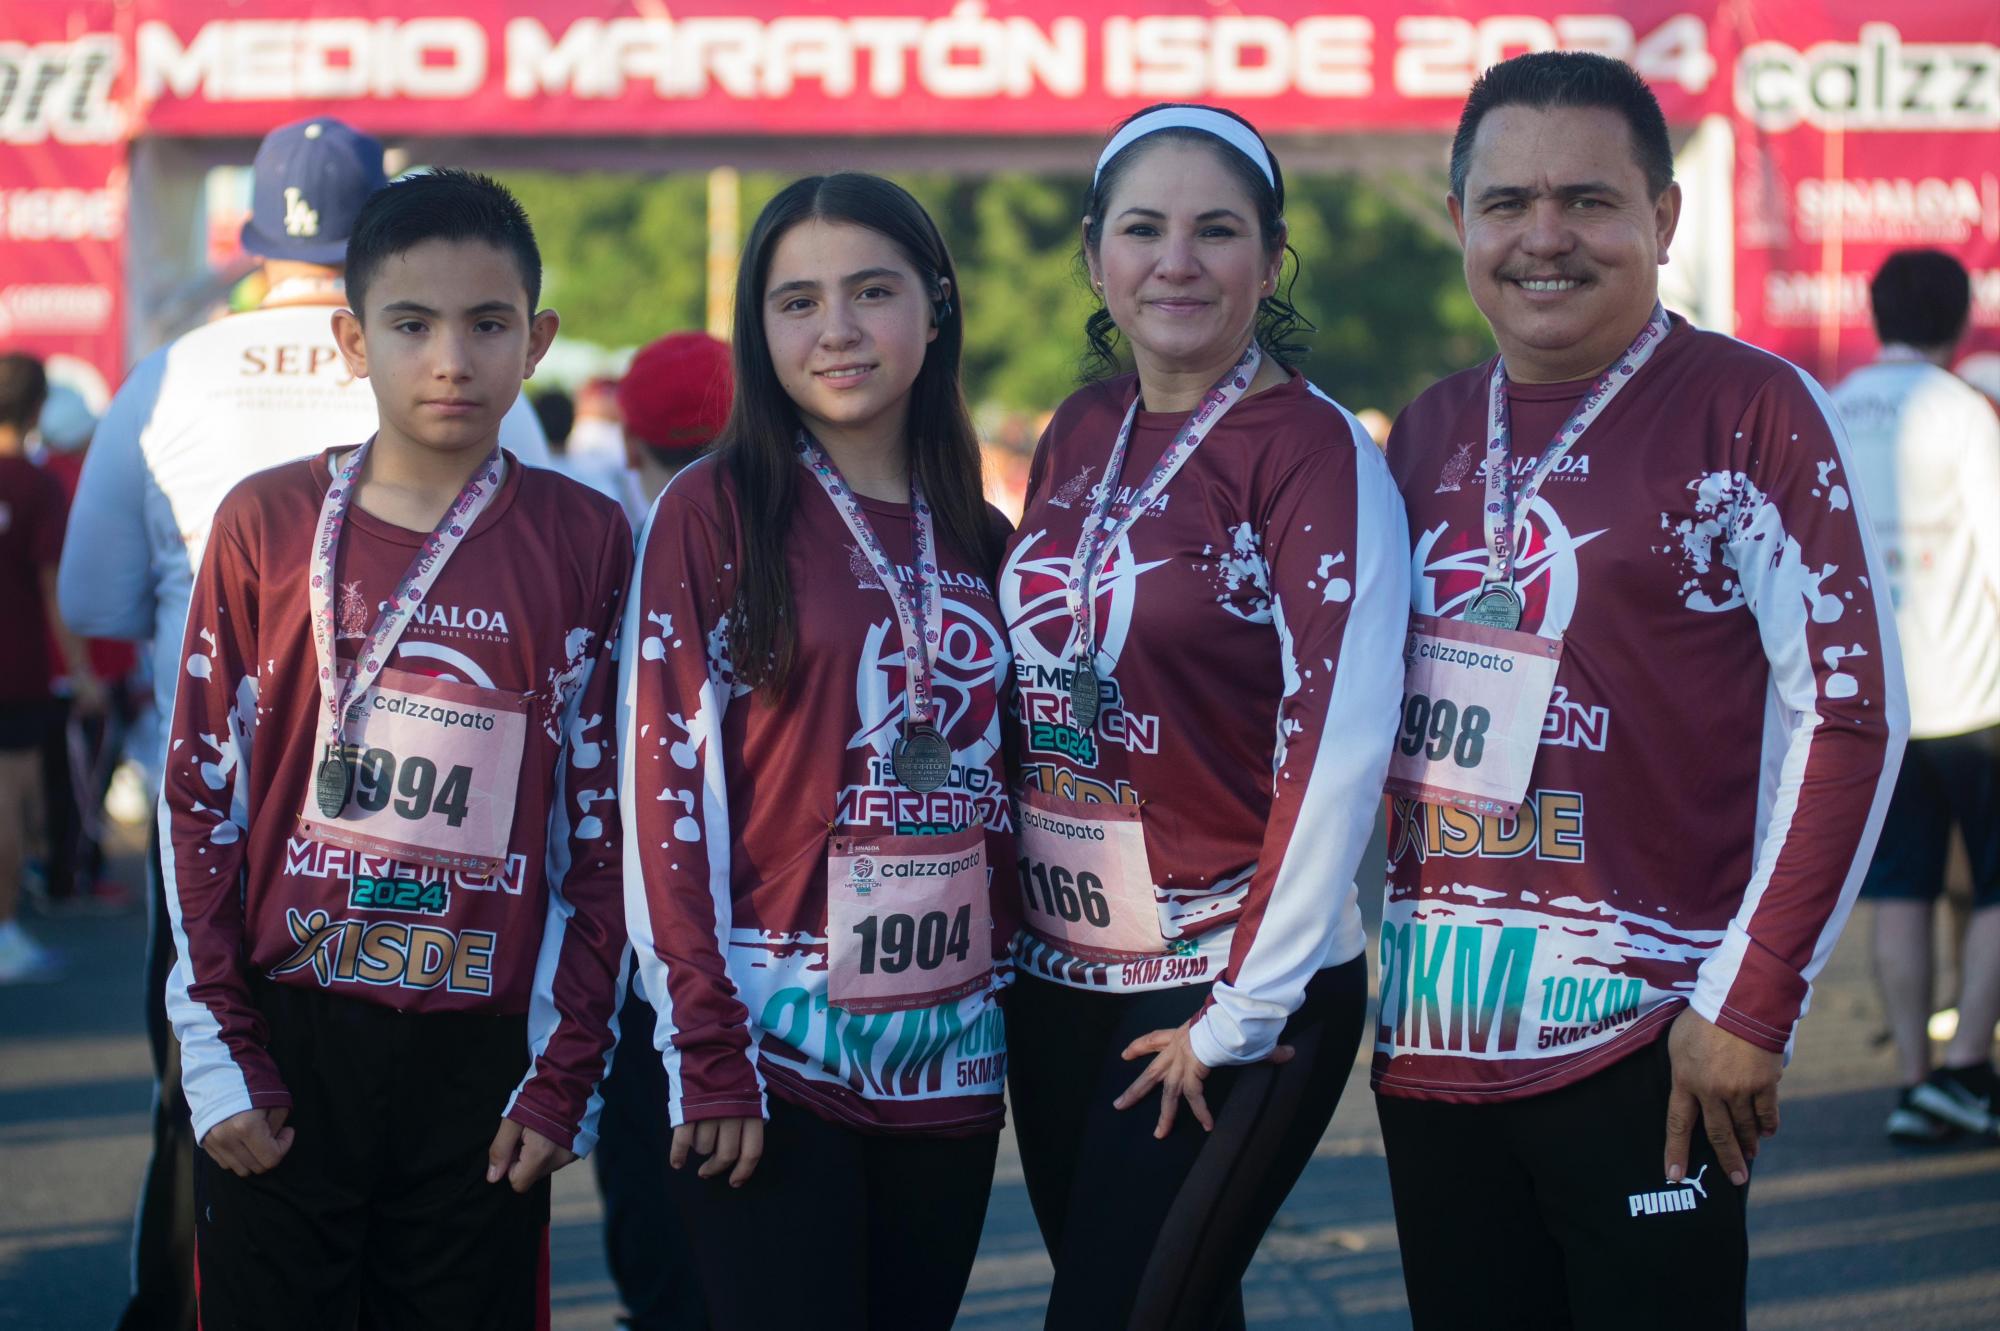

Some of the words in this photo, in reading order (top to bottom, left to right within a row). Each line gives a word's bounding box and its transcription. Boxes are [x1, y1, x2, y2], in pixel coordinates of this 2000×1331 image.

[136, 17, 487, 99] MEDIO
[506, 0, 1086, 98] MARATÓN
[1106, 16, 1374, 98] ISDE
[1741, 38, 2000, 118] calzz
[1475, 454, 1590, 477] SNAOA
[421, 541, 445, 574] SALUD
[896, 565, 992, 595] INLOA
[378, 600, 509, 634] NALOA
[441, 630, 461, 639] DEL
[467, 632, 510, 644] ESTADO
[1420, 642, 1514, 673] calzzapato
[373, 695, 495, 731] calzzapato
[1031, 723, 1096, 765] 2024
[943, 764, 990, 792] DIO
[1024, 812, 1104, 840] calzzapato
[1427, 789, 1585, 863] ISDE
[881, 852, 980, 878] calzzapato
[351, 877, 448, 913] 2024
[1018, 856, 1111, 928] 1166
[852, 904, 972, 975] 1904
[333, 919, 497, 996] ISDE
[1121, 959, 1161, 986] 5KM
[1377, 920, 1538, 1053] 21KM
[1539, 975, 1643, 1023] 10KM
[1628, 1188, 1697, 1217] PUMA
